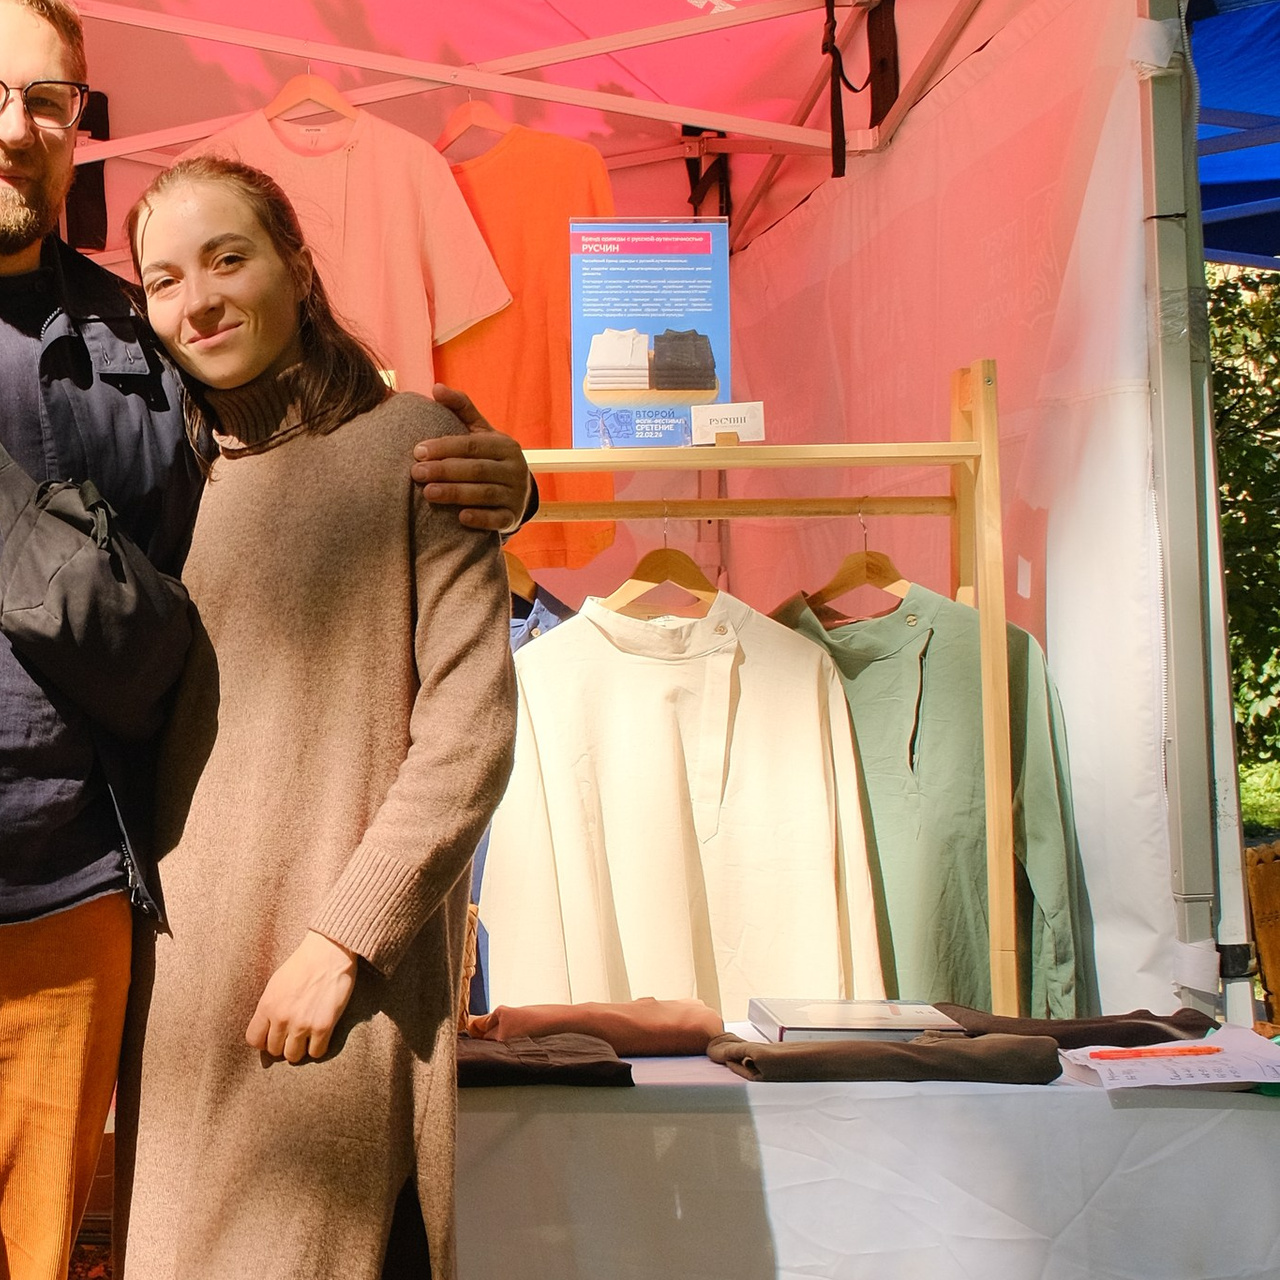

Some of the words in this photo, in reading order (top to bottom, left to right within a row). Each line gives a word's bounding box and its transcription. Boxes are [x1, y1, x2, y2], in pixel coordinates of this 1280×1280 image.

[581, 244, 620, 253] РУСЧИН
[635, 408, 675, 419] ВТОРОЙ
[635, 424, 675, 432] СРЕТЕНИЕ
